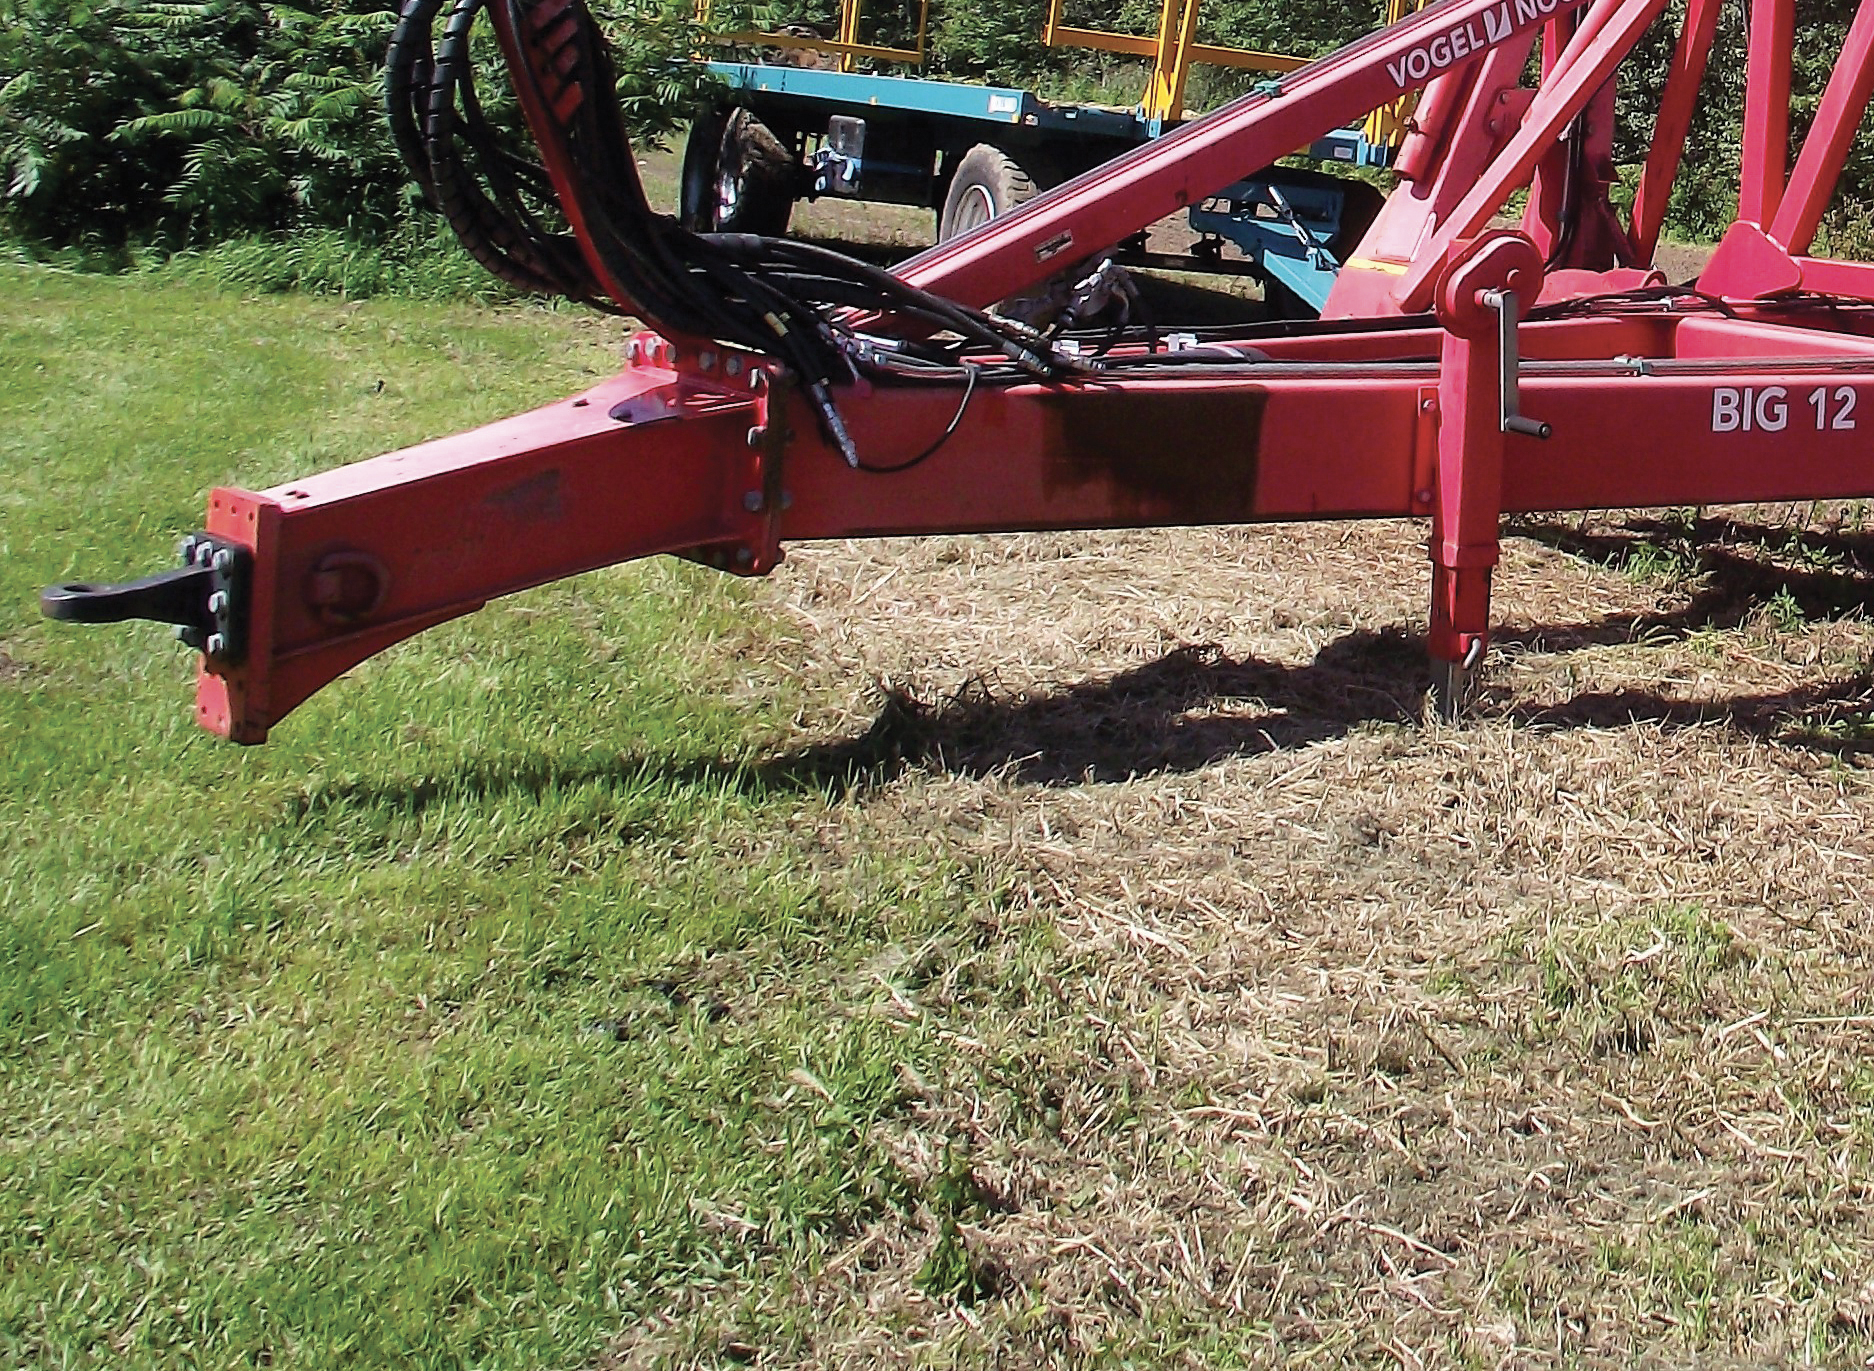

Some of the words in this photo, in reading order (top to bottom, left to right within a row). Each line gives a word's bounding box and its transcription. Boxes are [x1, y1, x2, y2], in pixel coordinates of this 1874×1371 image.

[1386, 20, 1485, 88] VOGEL
[1712, 386, 1788, 432] BIG
[1808, 386, 1857, 430] 12
